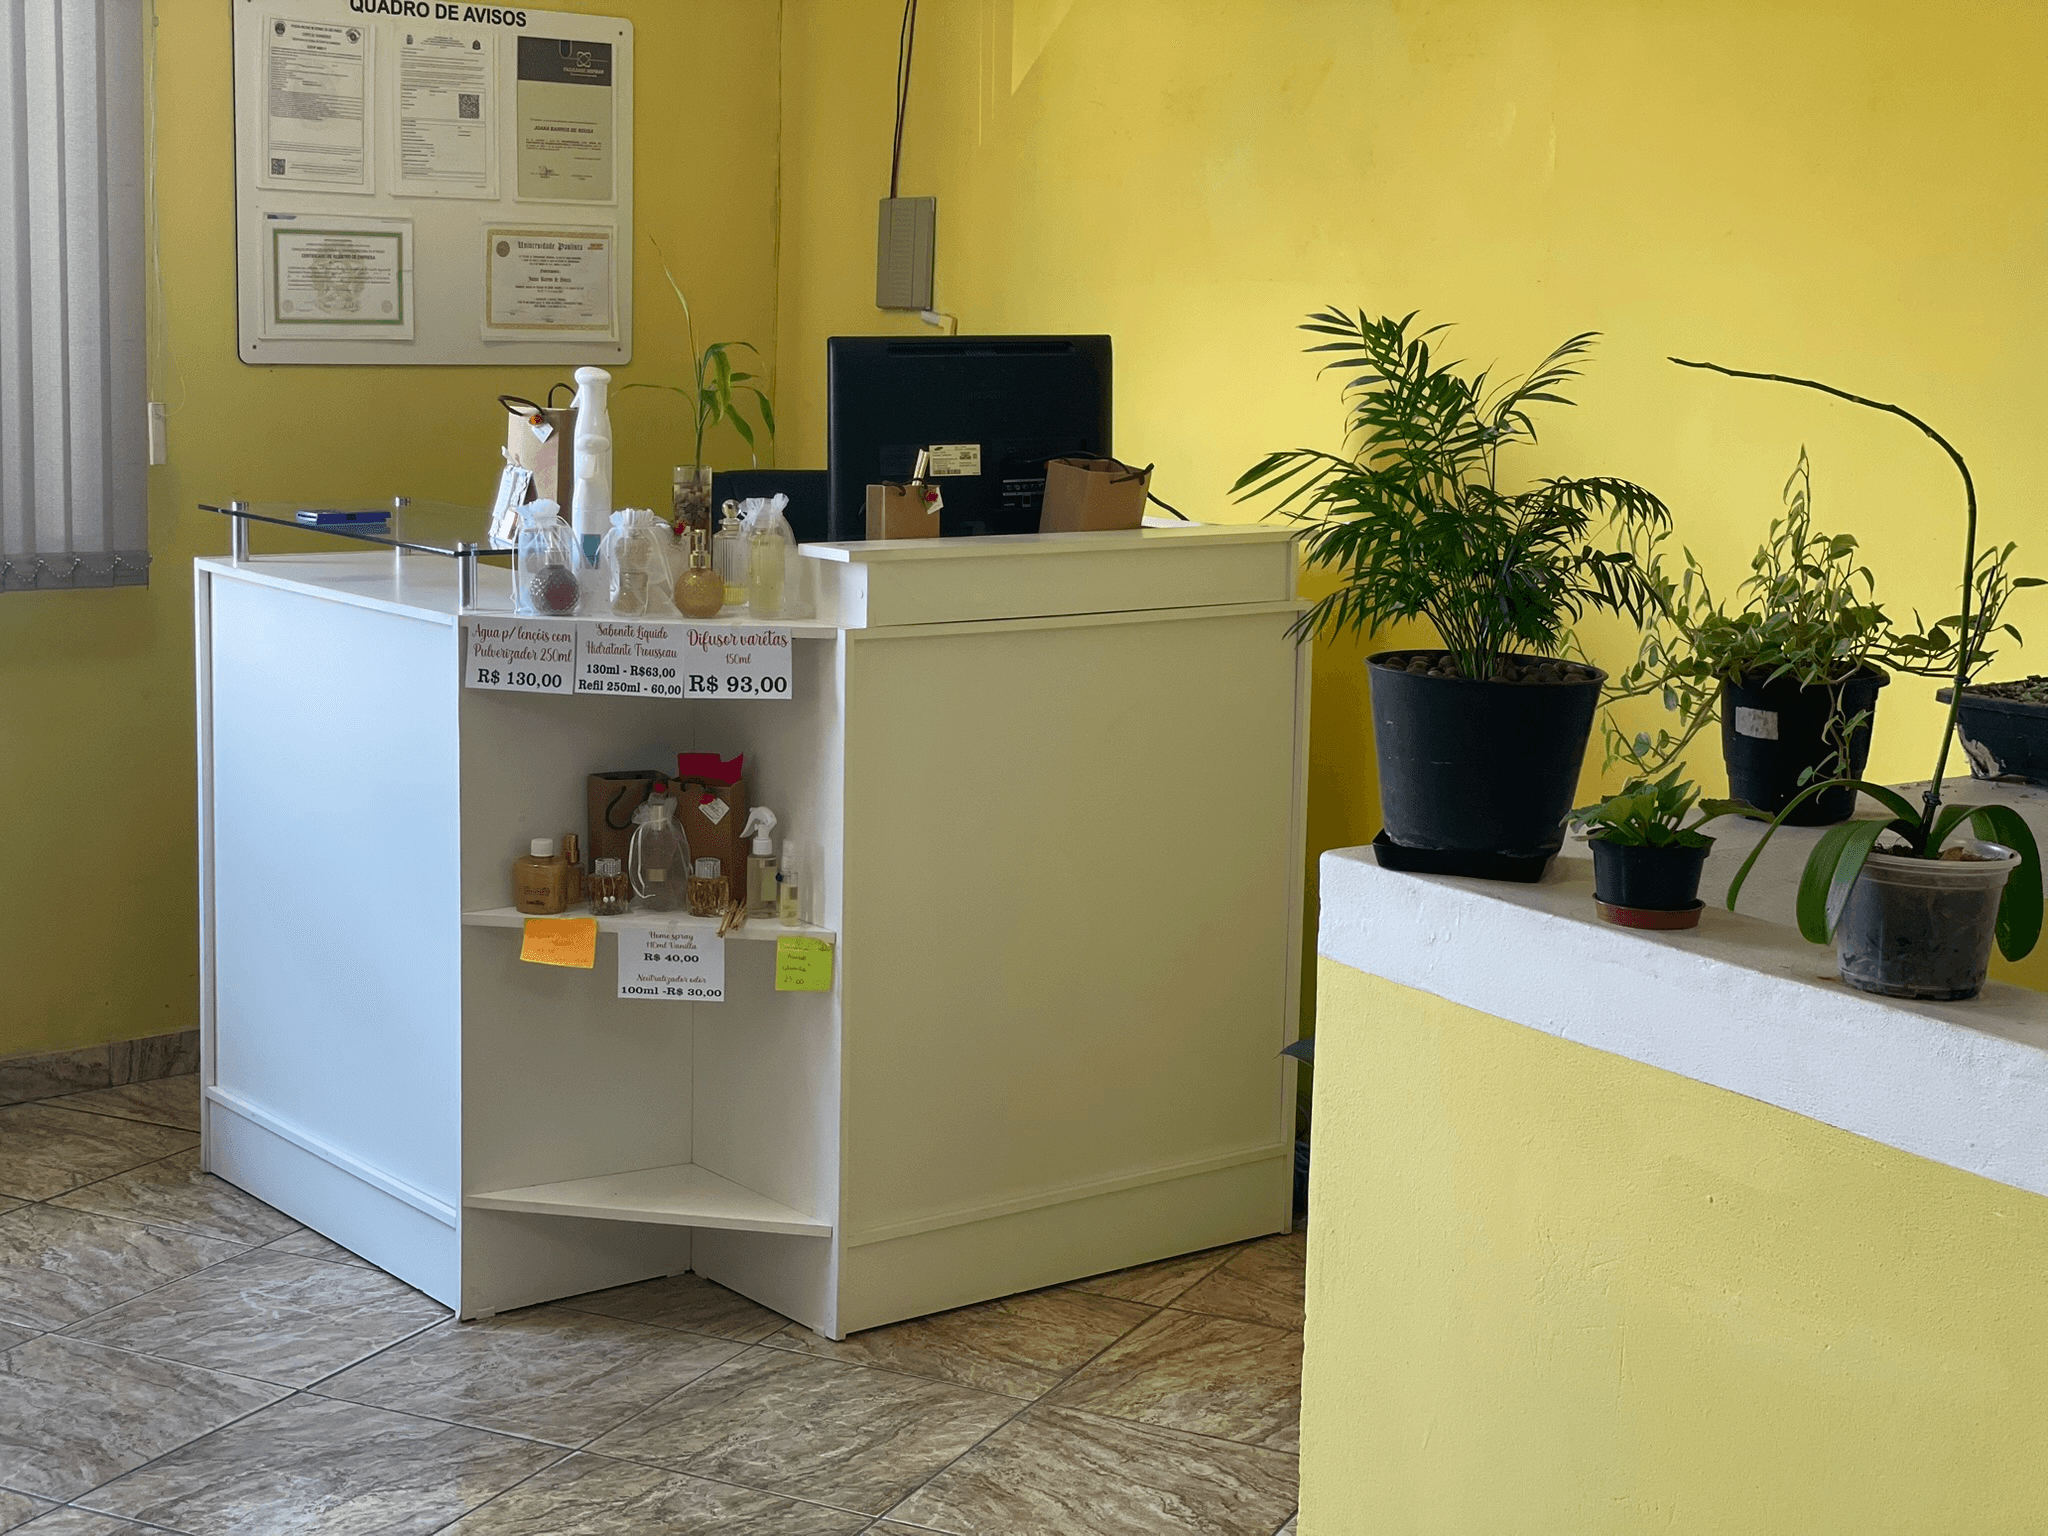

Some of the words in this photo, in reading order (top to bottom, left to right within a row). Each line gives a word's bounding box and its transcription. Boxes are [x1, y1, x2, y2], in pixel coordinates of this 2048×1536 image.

[350, 0, 430, 18] QUADRO
[435, 4, 459, 21] DE
[463, 7, 527, 27] AVISOS
[472, 623, 501, 643] Agua
[502, 626, 516, 642] p/
[552, 633, 572, 642] com
[596, 623, 635, 637] Sabonete
[686, 629, 738, 653] Difusor
[740, 630, 789, 648] varetas
[473, 643, 538, 665] Pulverizador
[540, 647, 573, 662] 250ml
[585, 640, 632, 656] Hidratante
[634, 643, 678, 659] Trousseau
[725, 653, 752, 664] 150ml
[477, 668, 500, 685] R$
[507, 671, 562, 688] 130,00
[587, 664, 620, 675] 130ml
[630, 665, 675, 679] R$63,00
[578, 679, 603, 690] Refil
[607, 681, 640, 692] 250ml
[651, 684, 681, 696] 60,00
[689, 674, 718, 694] R$
[727, 676, 787, 695] 93,00
[672, 933, 693, 941] spray
[668, 941, 697, 950] Vanilla
[644, 953, 661, 962] R$
[665, 954, 699, 963] 40,00
[636, 973, 688, 985] Neutralizador
[621, 986, 659, 995] 100ml
[687, 988, 722, 997] 30,00
